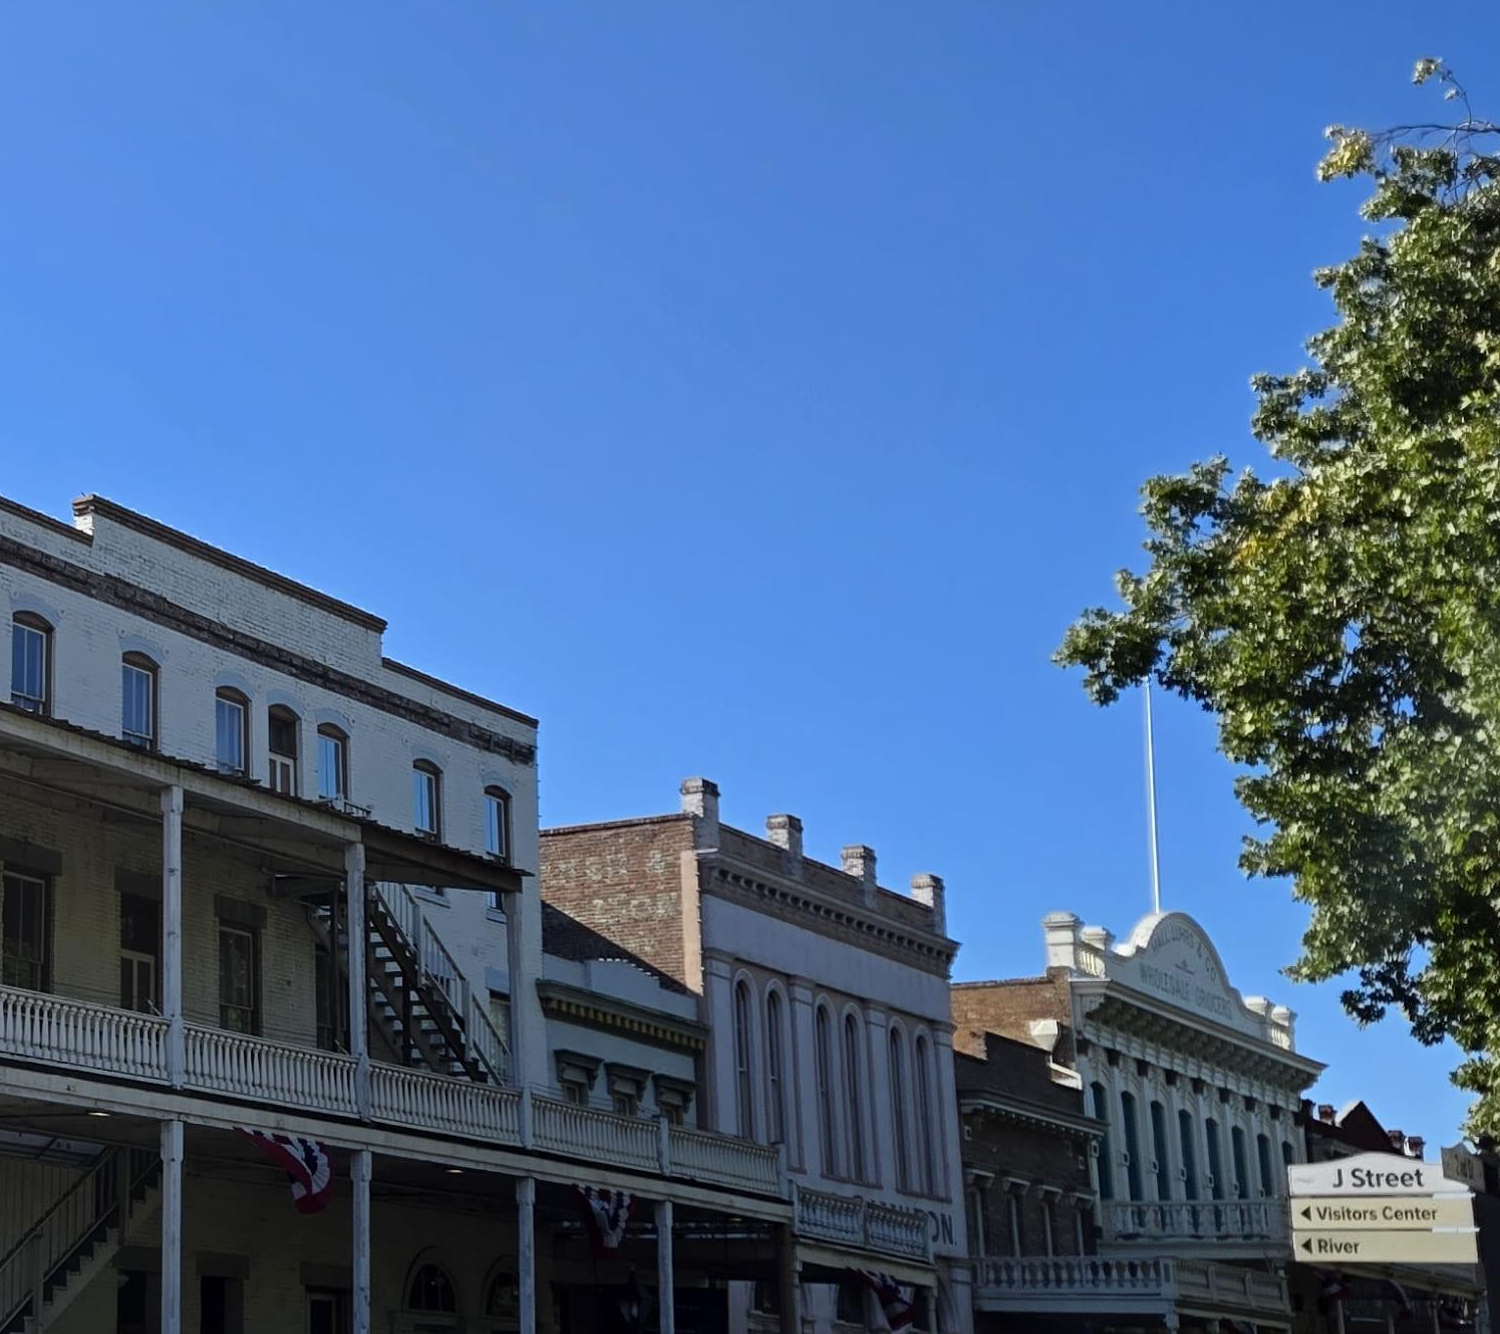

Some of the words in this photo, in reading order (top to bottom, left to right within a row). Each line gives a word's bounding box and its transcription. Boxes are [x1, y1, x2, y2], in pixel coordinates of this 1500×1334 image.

[1139, 962, 1190, 1003] WHOLESALE
[1196, 986, 1233, 1020] GROCERS
[1333, 1169, 1343, 1188] J
[1350, 1168, 1425, 1188] Street
[1316, 1205, 1378, 1221] Visitors
[1382, 1206, 1438, 1221] Center
[1317, 1238, 1360, 1254] River
